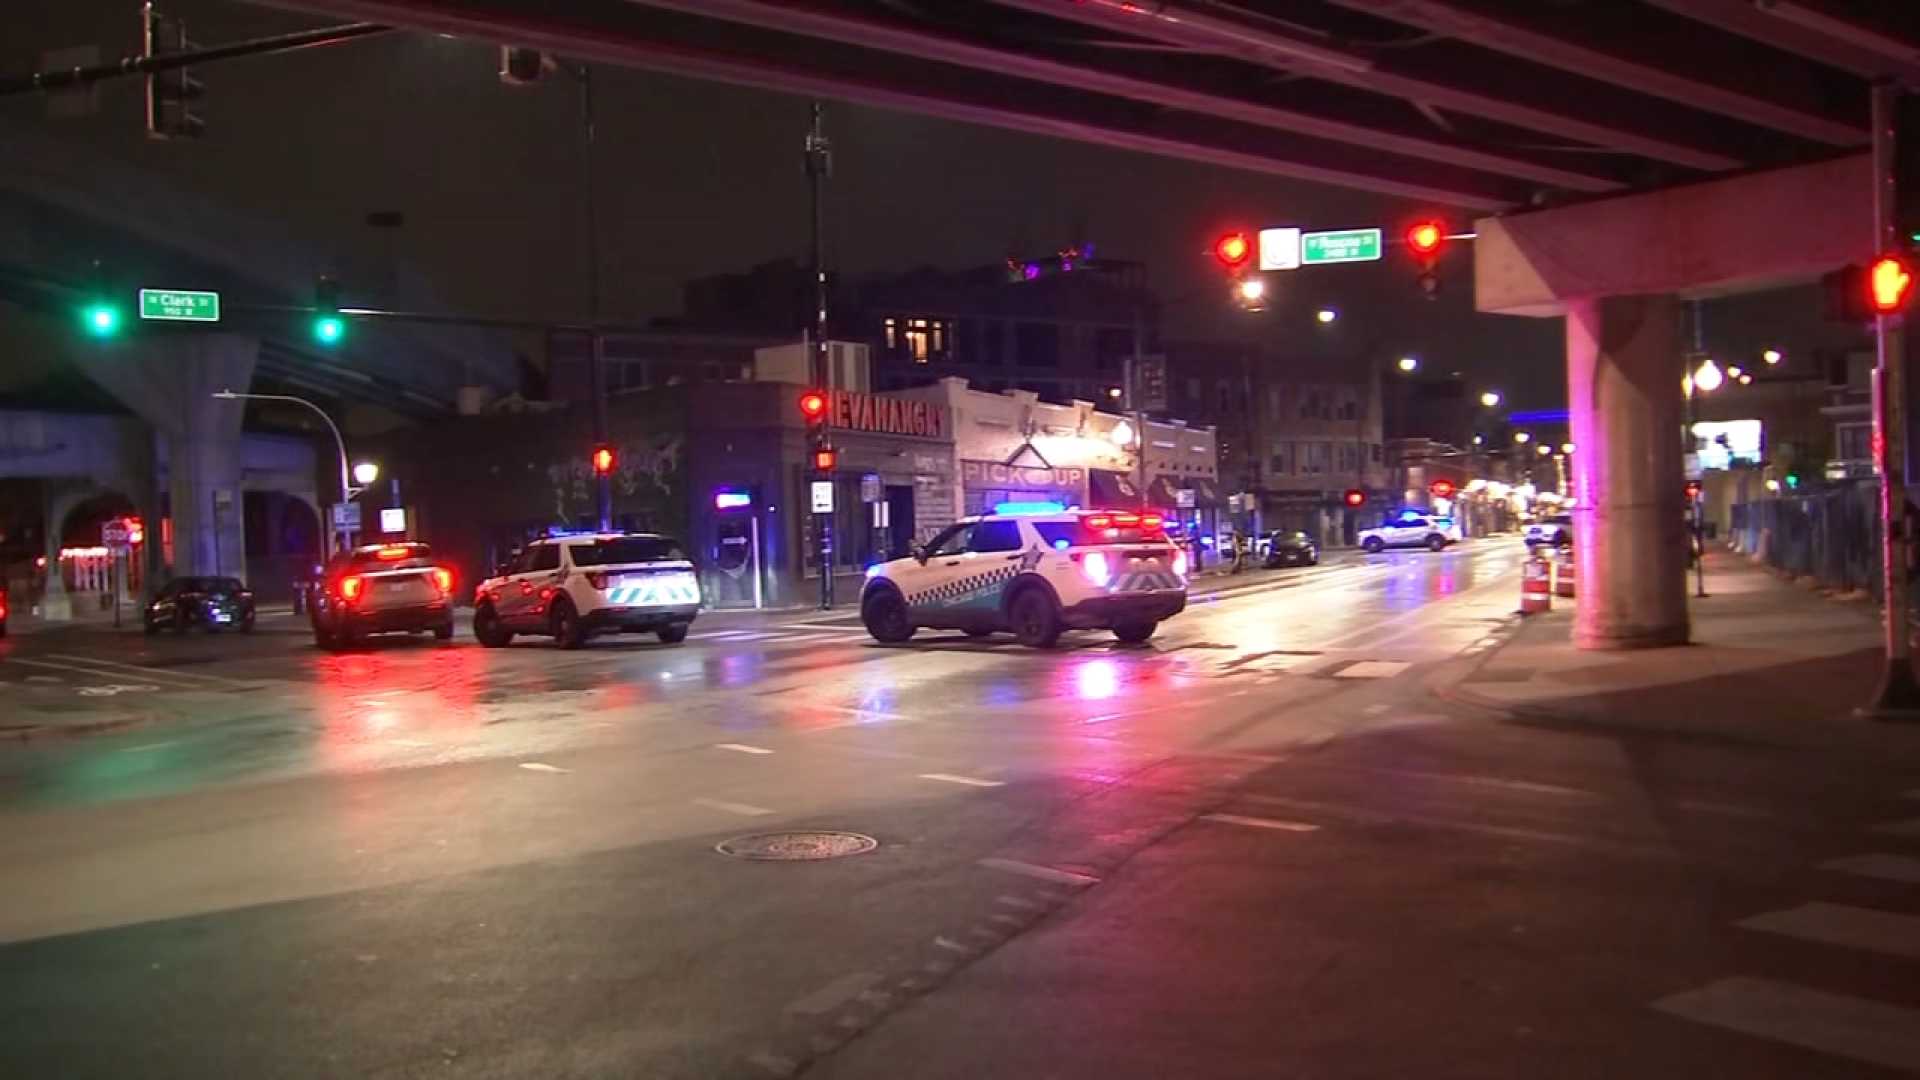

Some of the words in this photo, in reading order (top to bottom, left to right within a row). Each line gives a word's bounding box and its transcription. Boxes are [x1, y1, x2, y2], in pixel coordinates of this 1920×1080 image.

[160, 294, 195, 307] Clark
[965, 463, 1028, 486] PICK
[1055, 468, 1081, 485] UP
